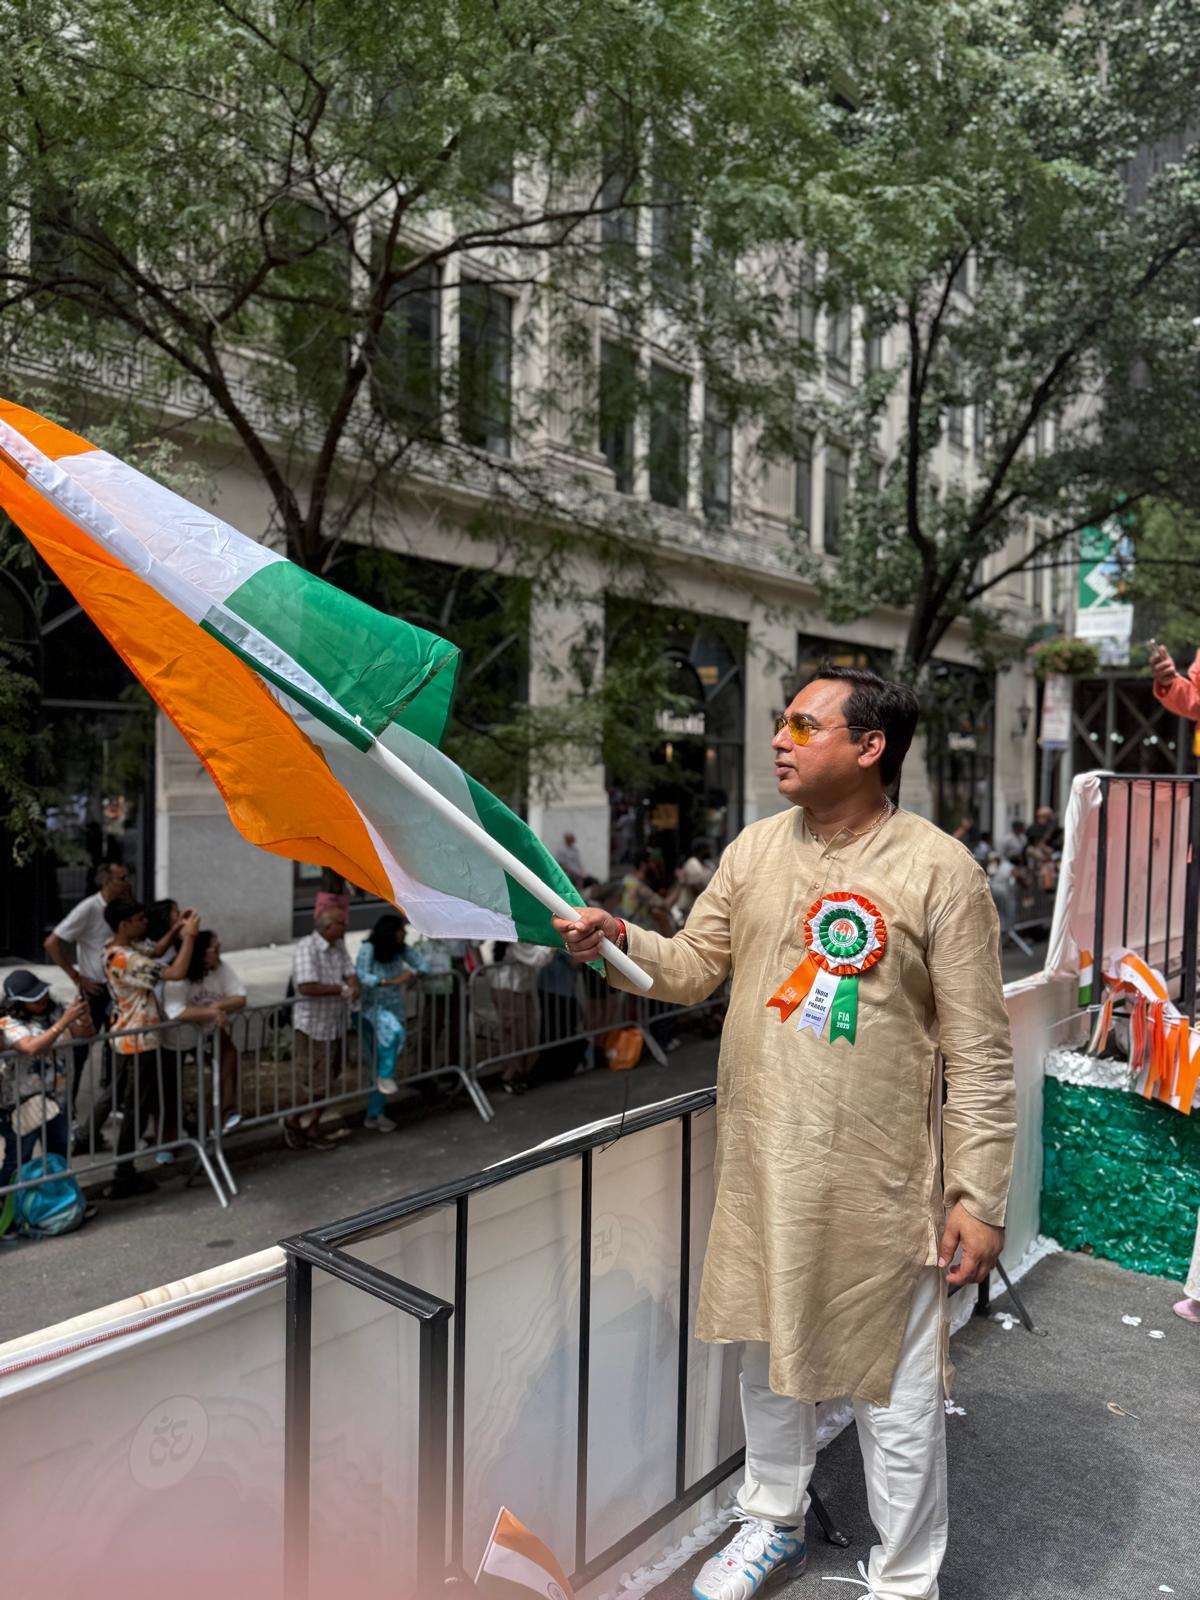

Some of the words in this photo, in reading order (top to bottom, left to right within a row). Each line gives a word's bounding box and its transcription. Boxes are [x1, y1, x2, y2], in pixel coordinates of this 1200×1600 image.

[815, 988, 829, 998] INDIA
[808, 1001, 827, 1012] PARADE
[837, 1012, 850, 1022] FIA
